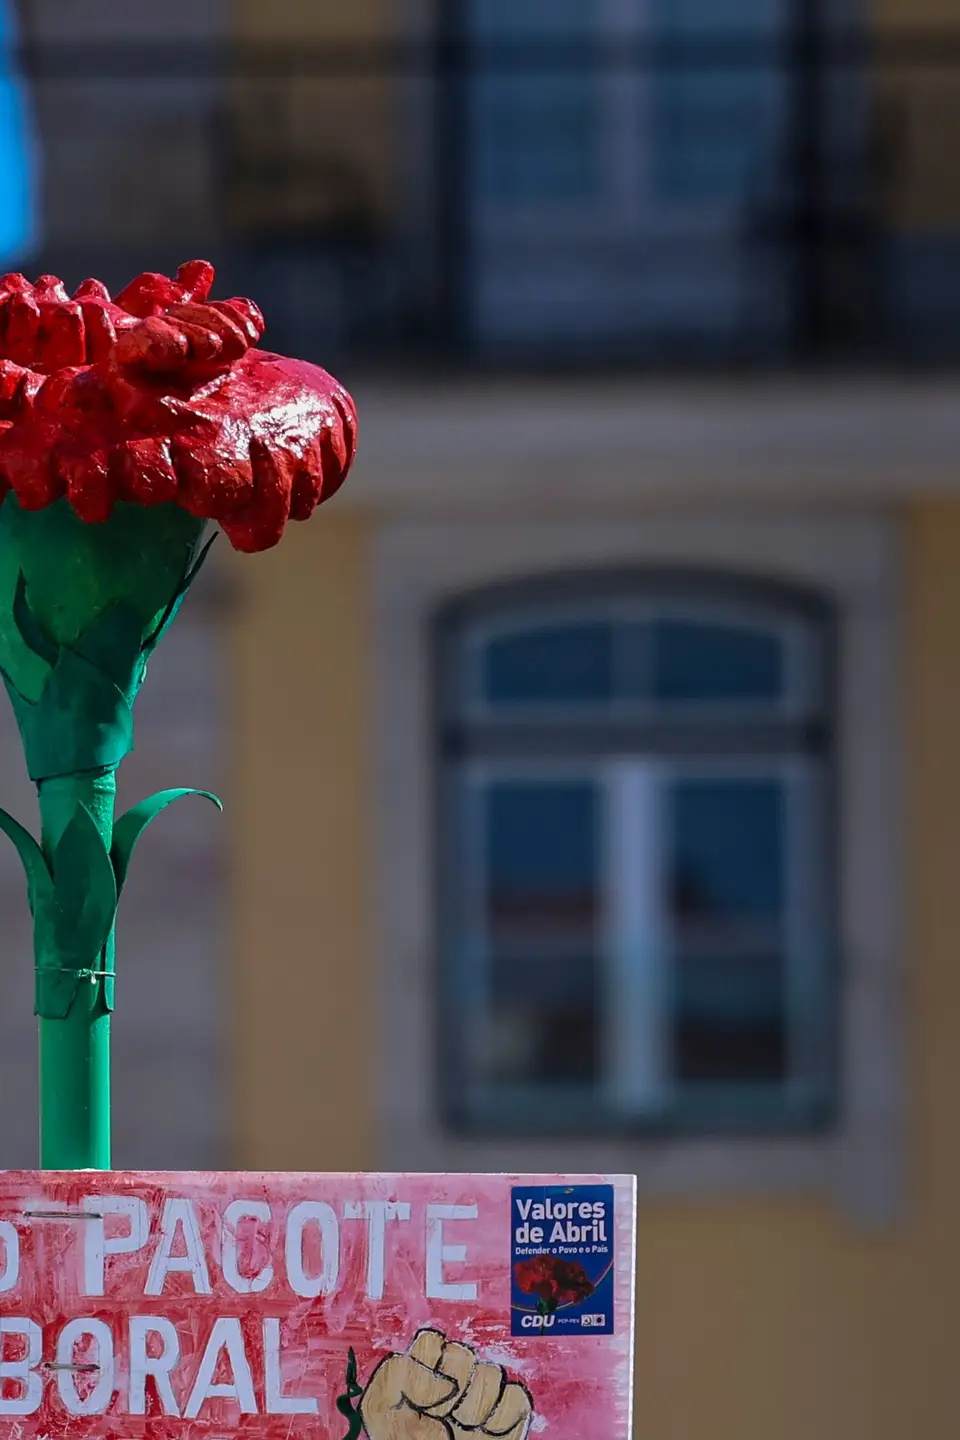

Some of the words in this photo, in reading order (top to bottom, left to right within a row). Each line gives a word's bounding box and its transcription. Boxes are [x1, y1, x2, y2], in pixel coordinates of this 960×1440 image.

[515, 1198, 606, 1221] Valores
[515, 1222, 544, 1244] de
[549, 1220, 608, 1243] Abril
[82, 1194, 480, 1301] PACOTE
[515, 1246, 550, 1255] Defender
[558, 1246, 578, 1254] Povo
[521, 1314, 556, 1328] CDU
